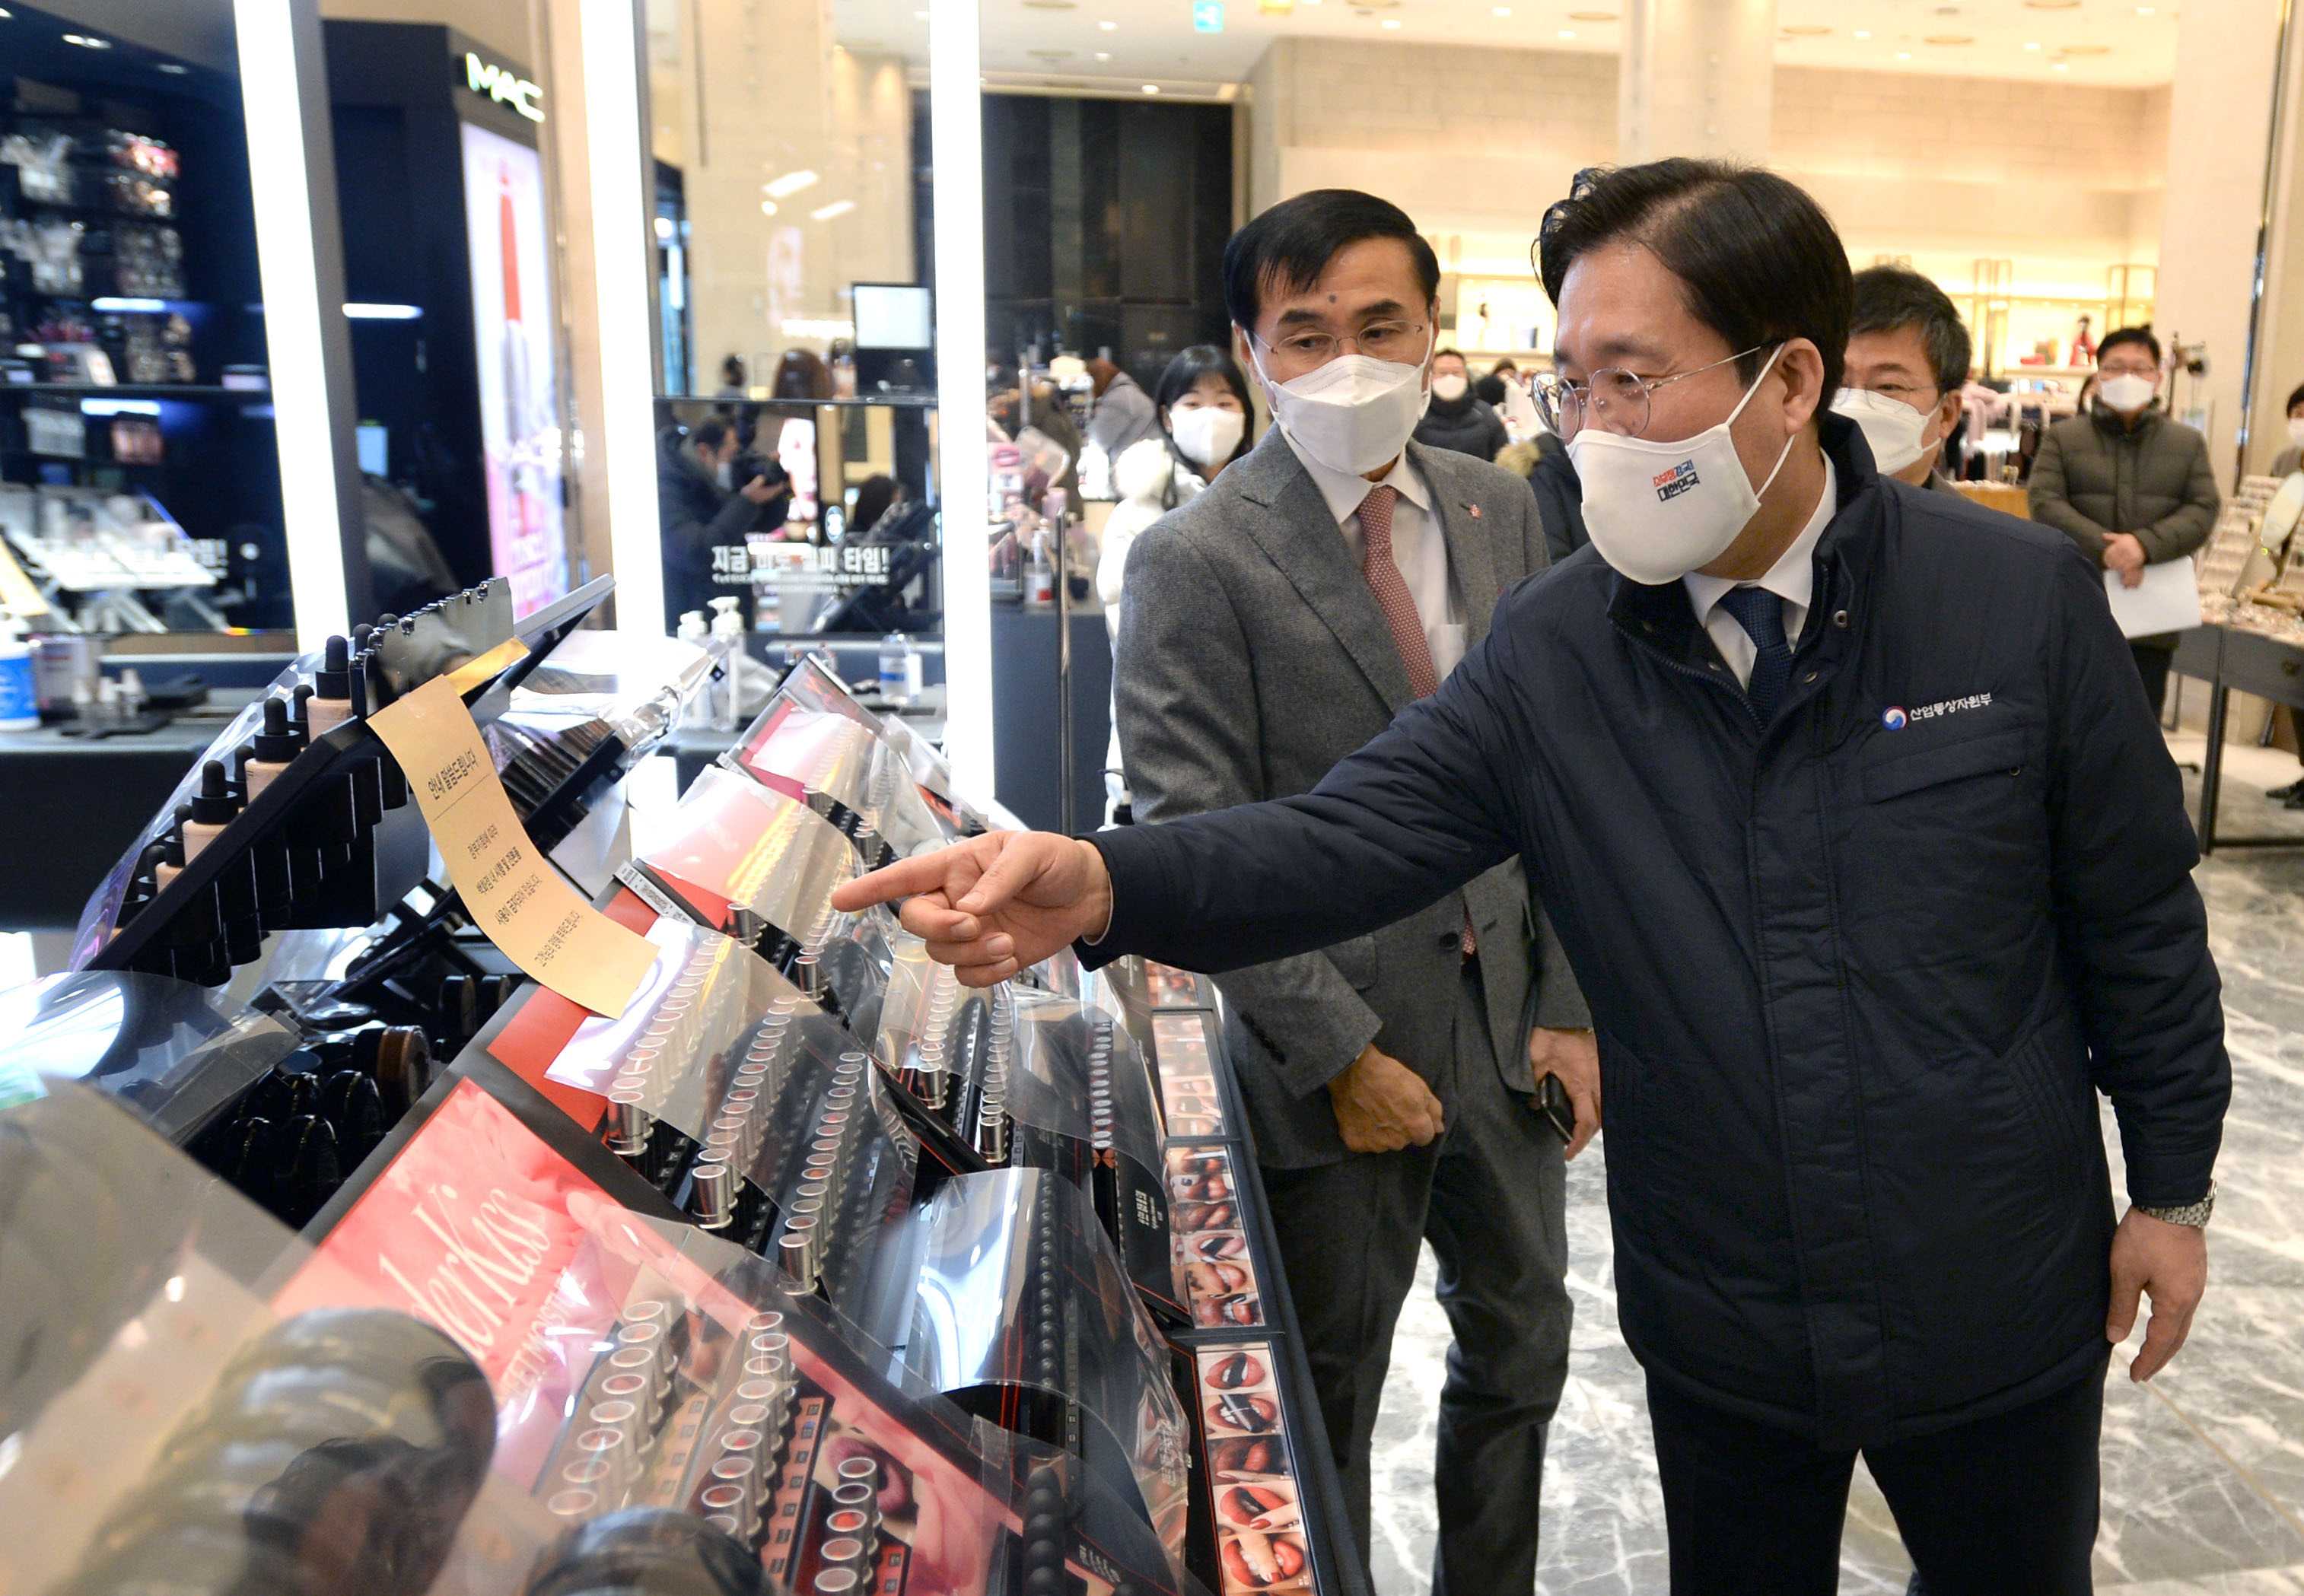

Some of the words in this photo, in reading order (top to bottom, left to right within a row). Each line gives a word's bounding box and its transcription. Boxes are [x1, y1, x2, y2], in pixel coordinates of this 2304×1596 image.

[466, 52, 546, 123] MAC
[1657, 471, 1700, 502] 대한민국
[712, 545, 749, 572] 지금
[843, 546, 889, 572] 타임!
[1910, 691, 1993, 721] 산업통상자원부
[428, 773, 446, 800] 안내
[441, 748, 479, 790] 말씀드립니다
[495, 905, 514, 925] 사용이
[506, 889, 528, 914] 금지되어
